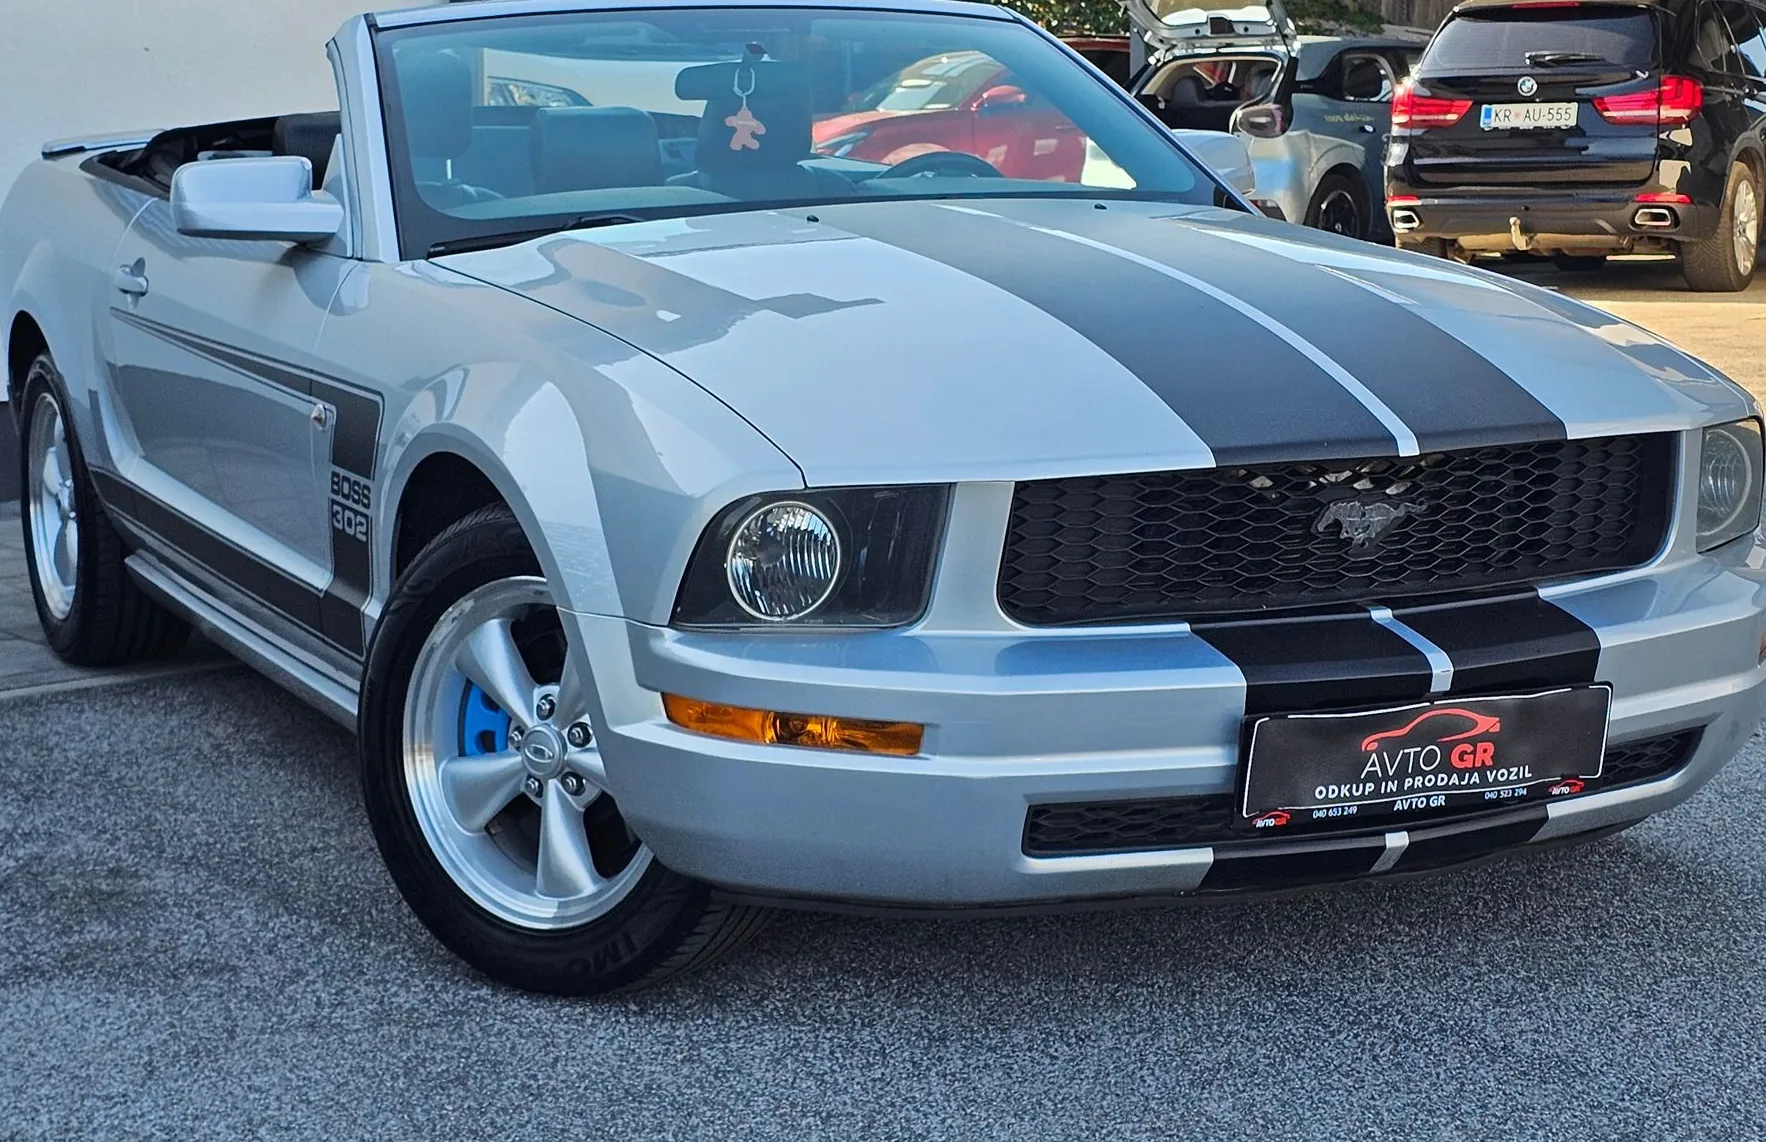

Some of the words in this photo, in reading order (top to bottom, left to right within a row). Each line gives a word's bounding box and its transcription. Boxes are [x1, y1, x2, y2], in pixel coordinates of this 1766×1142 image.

[1494, 108, 1512, 123] KR
[1523, 107, 1572, 122] AU-555
[331, 471, 371, 510] BOSS
[332, 505, 367, 542] 302
[1360, 745, 1441, 779] AVTO
[1450, 742, 1496, 769] GR
[1314, 782, 1375, 800] ODKUP
[1380, 780, 1398, 794] IN
[1404, 771, 1480, 791] PRODAJA
[1486, 765, 1533, 783] VOZIL
[1484, 790, 1498, 800] 040
[1499, 789, 1512, 799] 523
[1514, 787, 1527, 797] 294
[1312, 808, 1327, 819] 040
[1328, 807, 1342, 817] 653
[1343, 805, 1358, 816] 249
[1393, 797, 1427, 811] AVTO
[1429, 795, 1446, 808] GR
